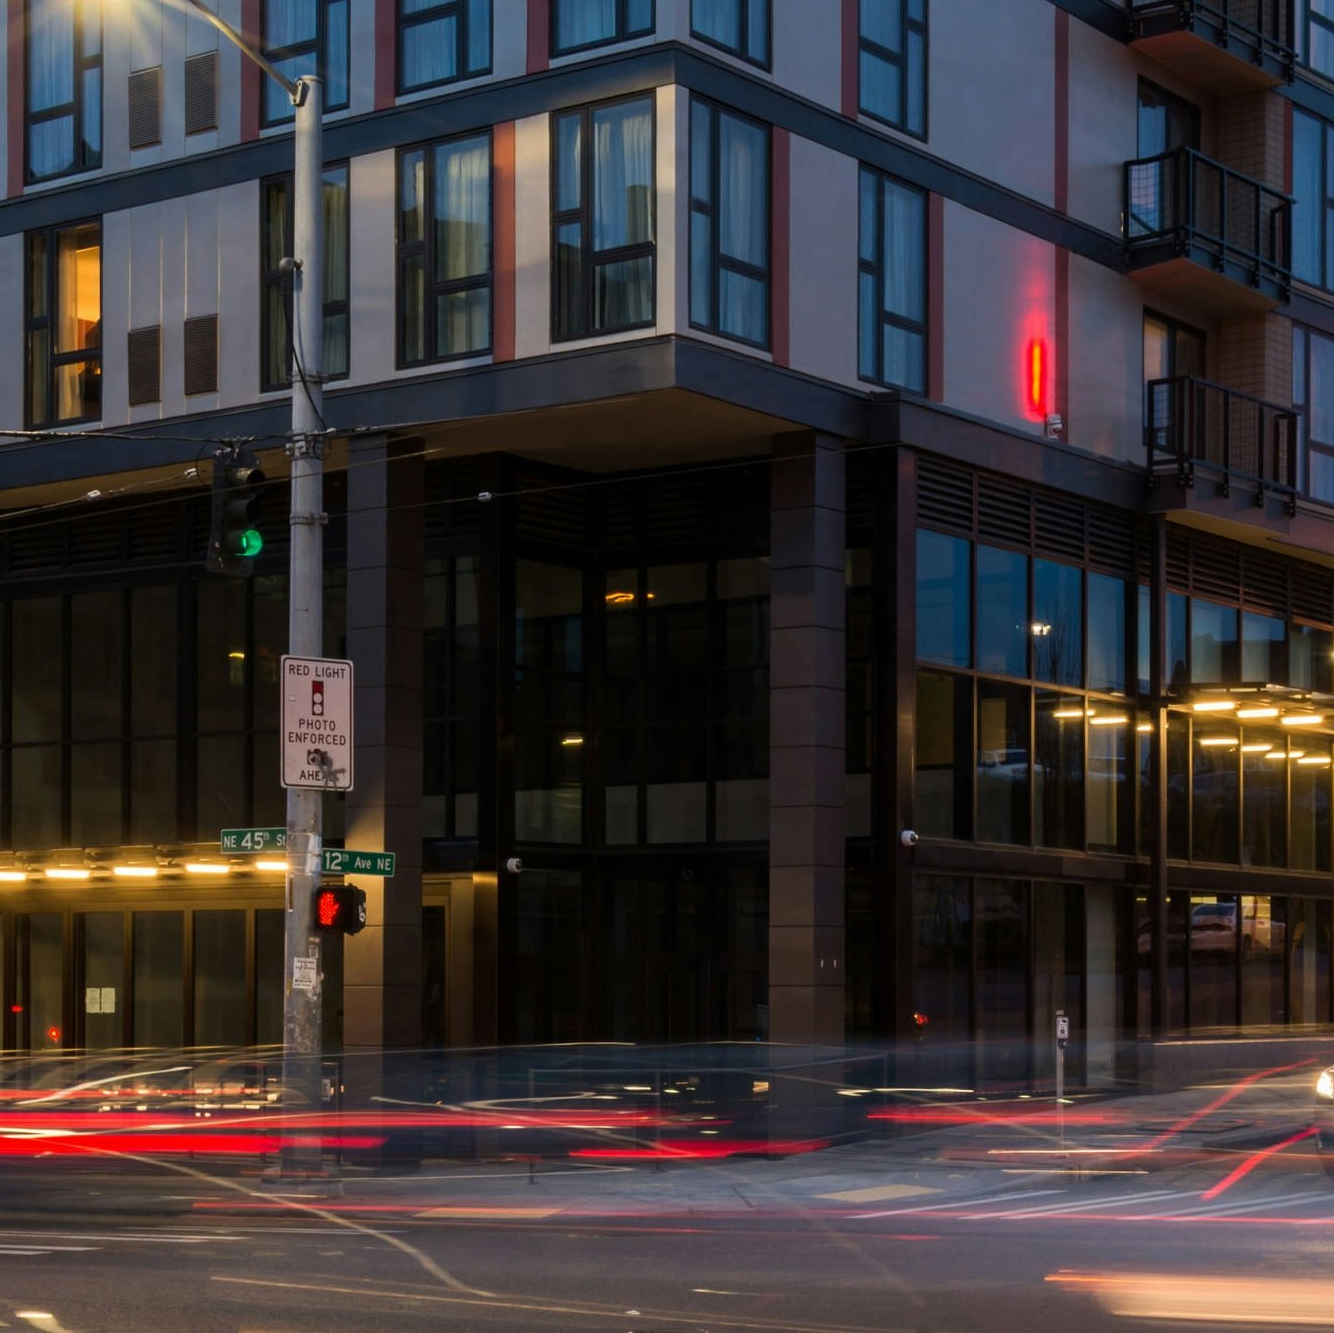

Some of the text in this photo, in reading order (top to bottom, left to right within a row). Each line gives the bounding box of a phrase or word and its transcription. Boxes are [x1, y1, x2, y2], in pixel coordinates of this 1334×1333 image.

[289, 664, 346, 679] RED LIGHT
[299, 718, 336, 731] PHOTO
[288, 732, 346, 746] ENFORCED
[224, 835, 237, 848] NE
[241, 832, 270, 850] 45th
[325, 852, 391, 871] 12th Ave NE
